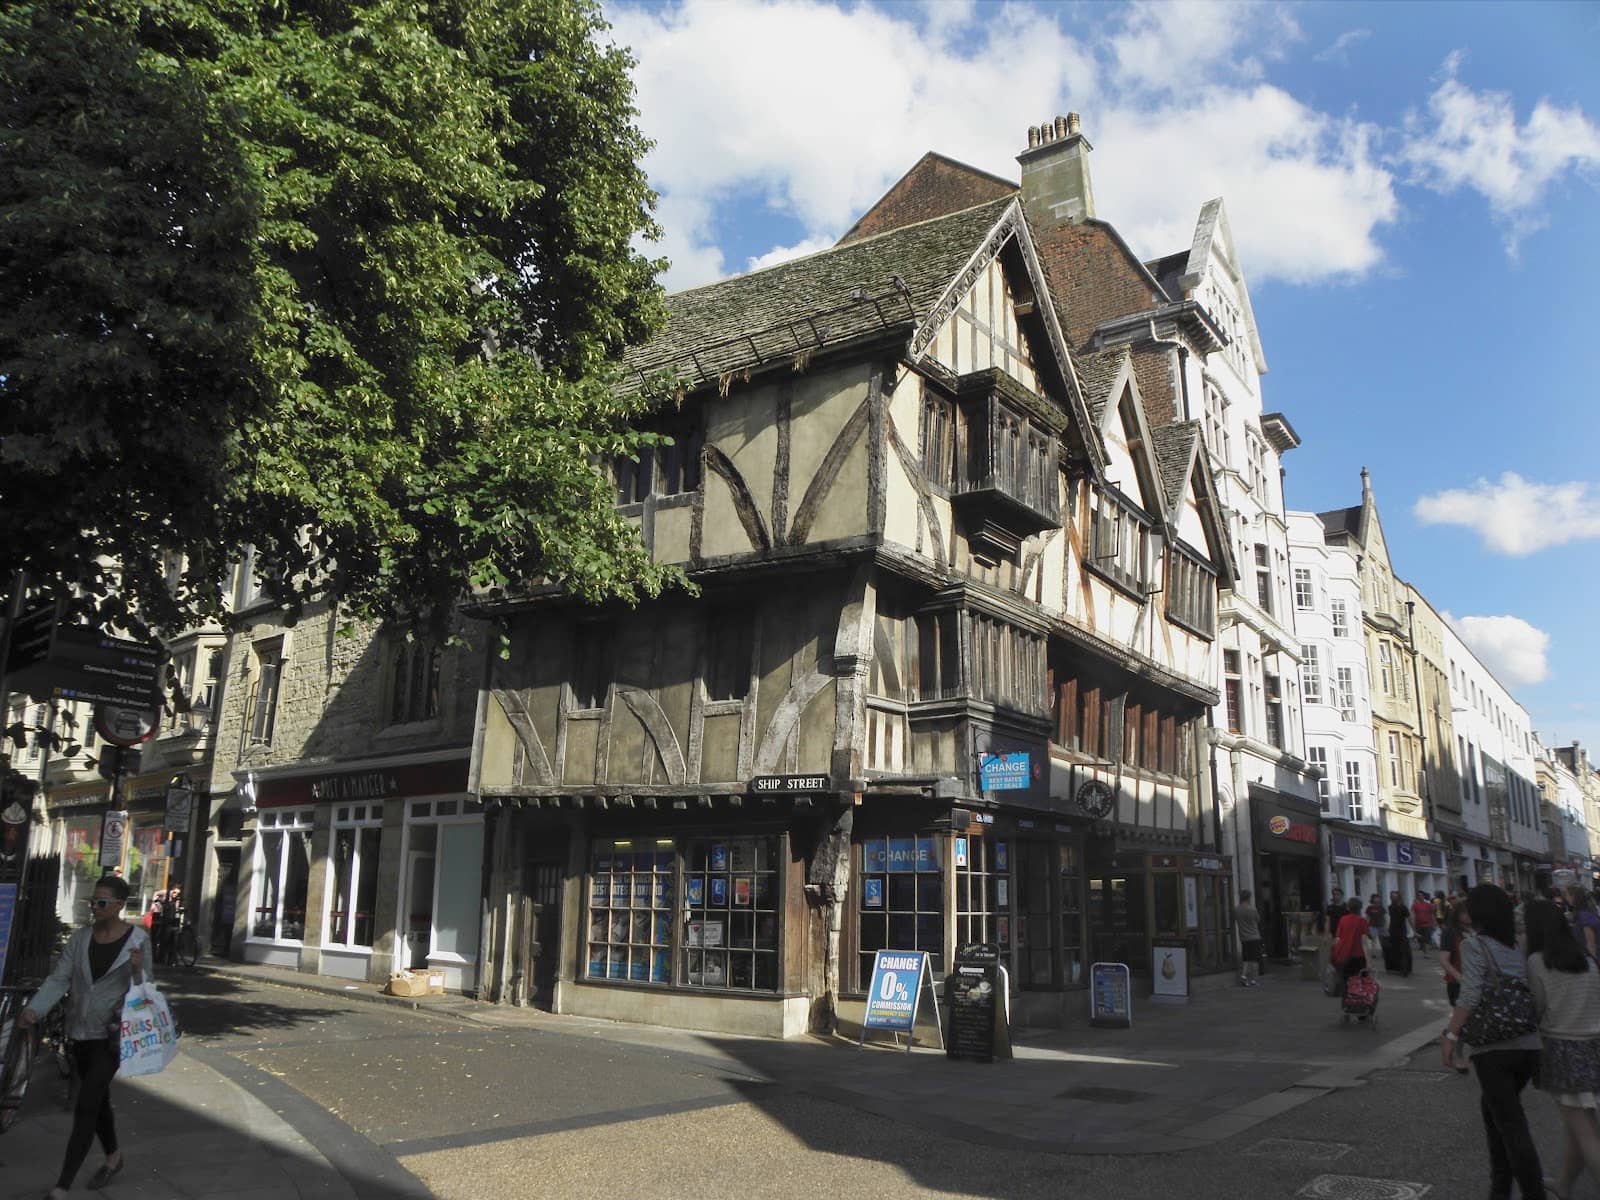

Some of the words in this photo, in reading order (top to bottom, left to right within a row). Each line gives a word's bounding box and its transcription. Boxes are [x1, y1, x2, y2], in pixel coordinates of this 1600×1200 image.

[984, 762, 1025, 773] CHANGE
[757, 778, 781, 791] SHIP
[786, 777, 825, 790] STREET
[878, 849, 928, 862] CHANGE
[880, 956, 919, 971] CHANGE
[880, 971, 908, 1001] 0%
[871, 1000, 912, 1011] COMMISSION
[120, 1010, 169, 1038] Russell
